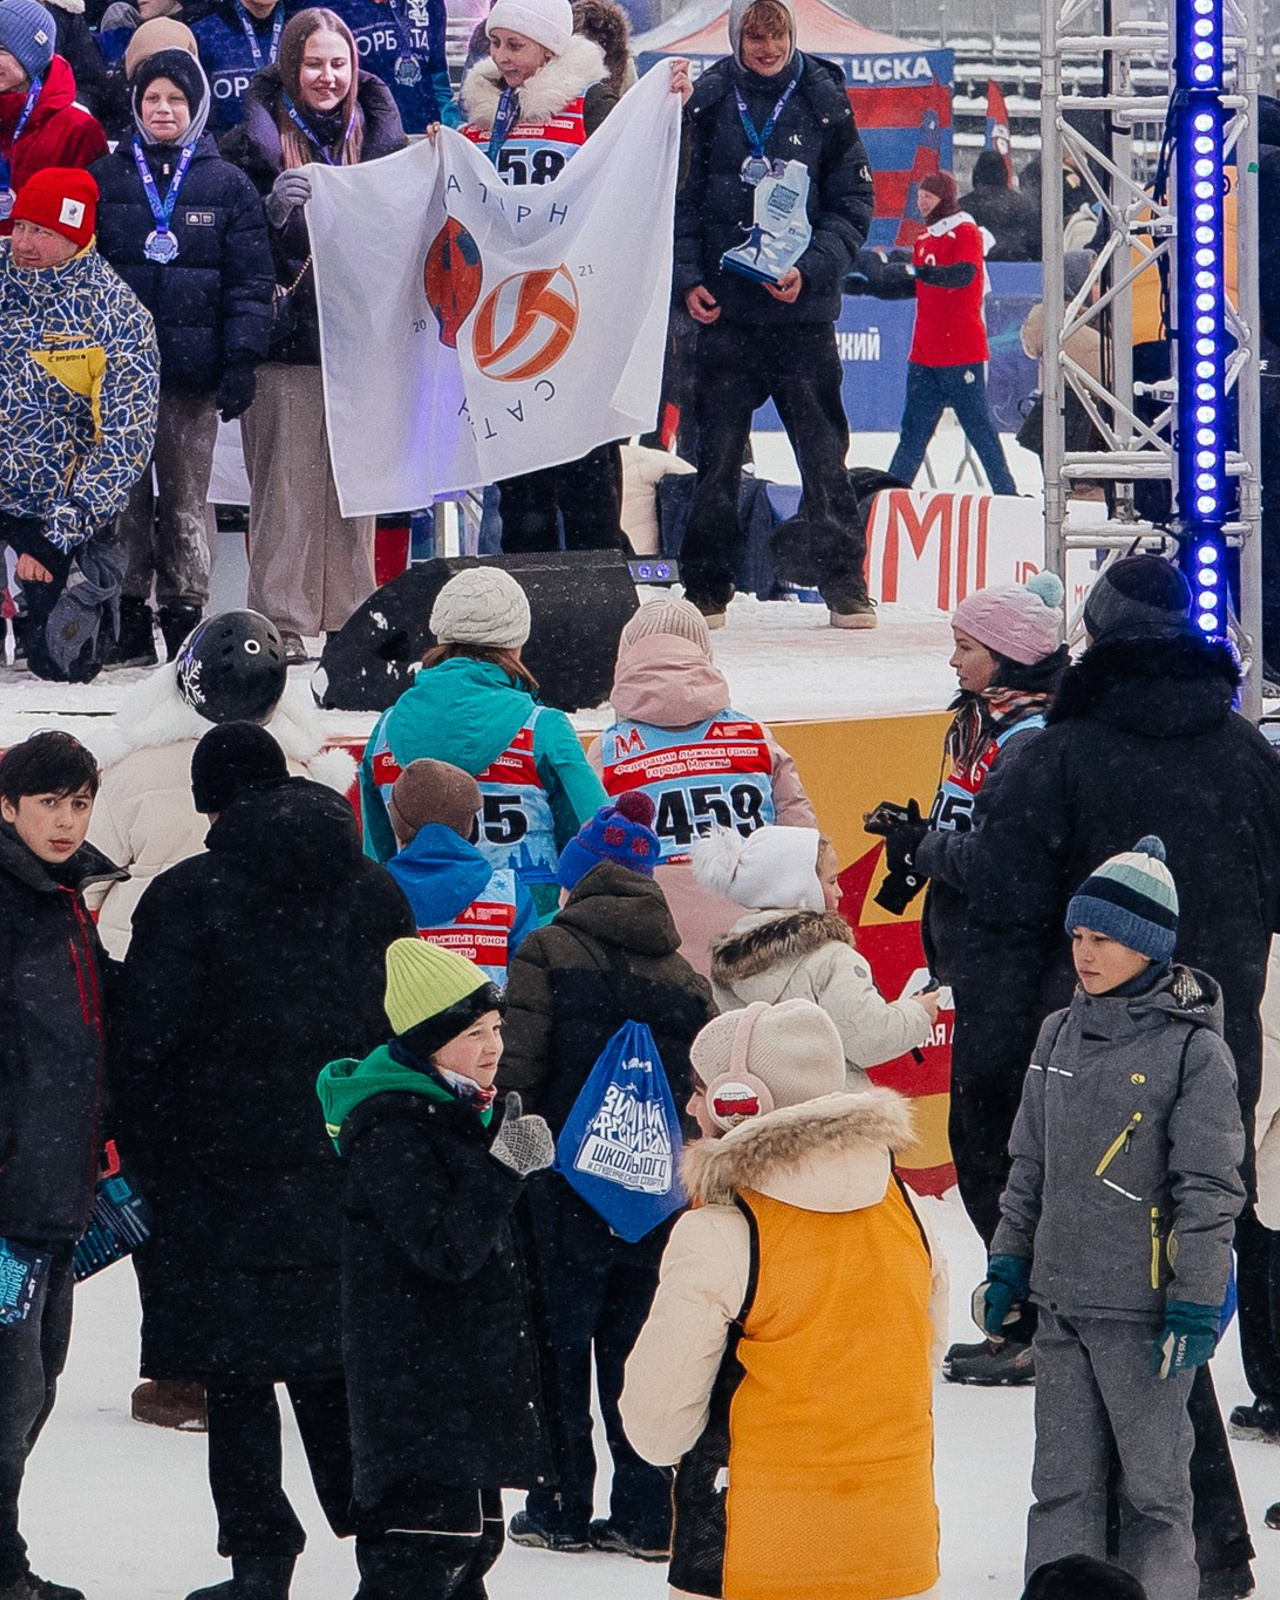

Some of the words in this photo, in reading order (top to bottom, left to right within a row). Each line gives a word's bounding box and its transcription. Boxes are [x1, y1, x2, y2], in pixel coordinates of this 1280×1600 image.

[354, 29, 430, 57] ОРБТА
[851, 58, 933, 84] ЦСКА
[497, 148, 566, 187] 58
[578, 264, 595, 278] 21
[413, 316, 428, 334] 20
[613, 749, 677, 775] Федерация
[678, 747, 727, 760] лыжных
[727, 746, 760, 757] гонок
[646, 763, 687, 779] города
[687, 759, 732, 771] Москвы
[470, 795, 528, 844] 5
[655, 783, 765, 846] 459
[591, 1143, 668, 1179] ШКОЛЬОГО
